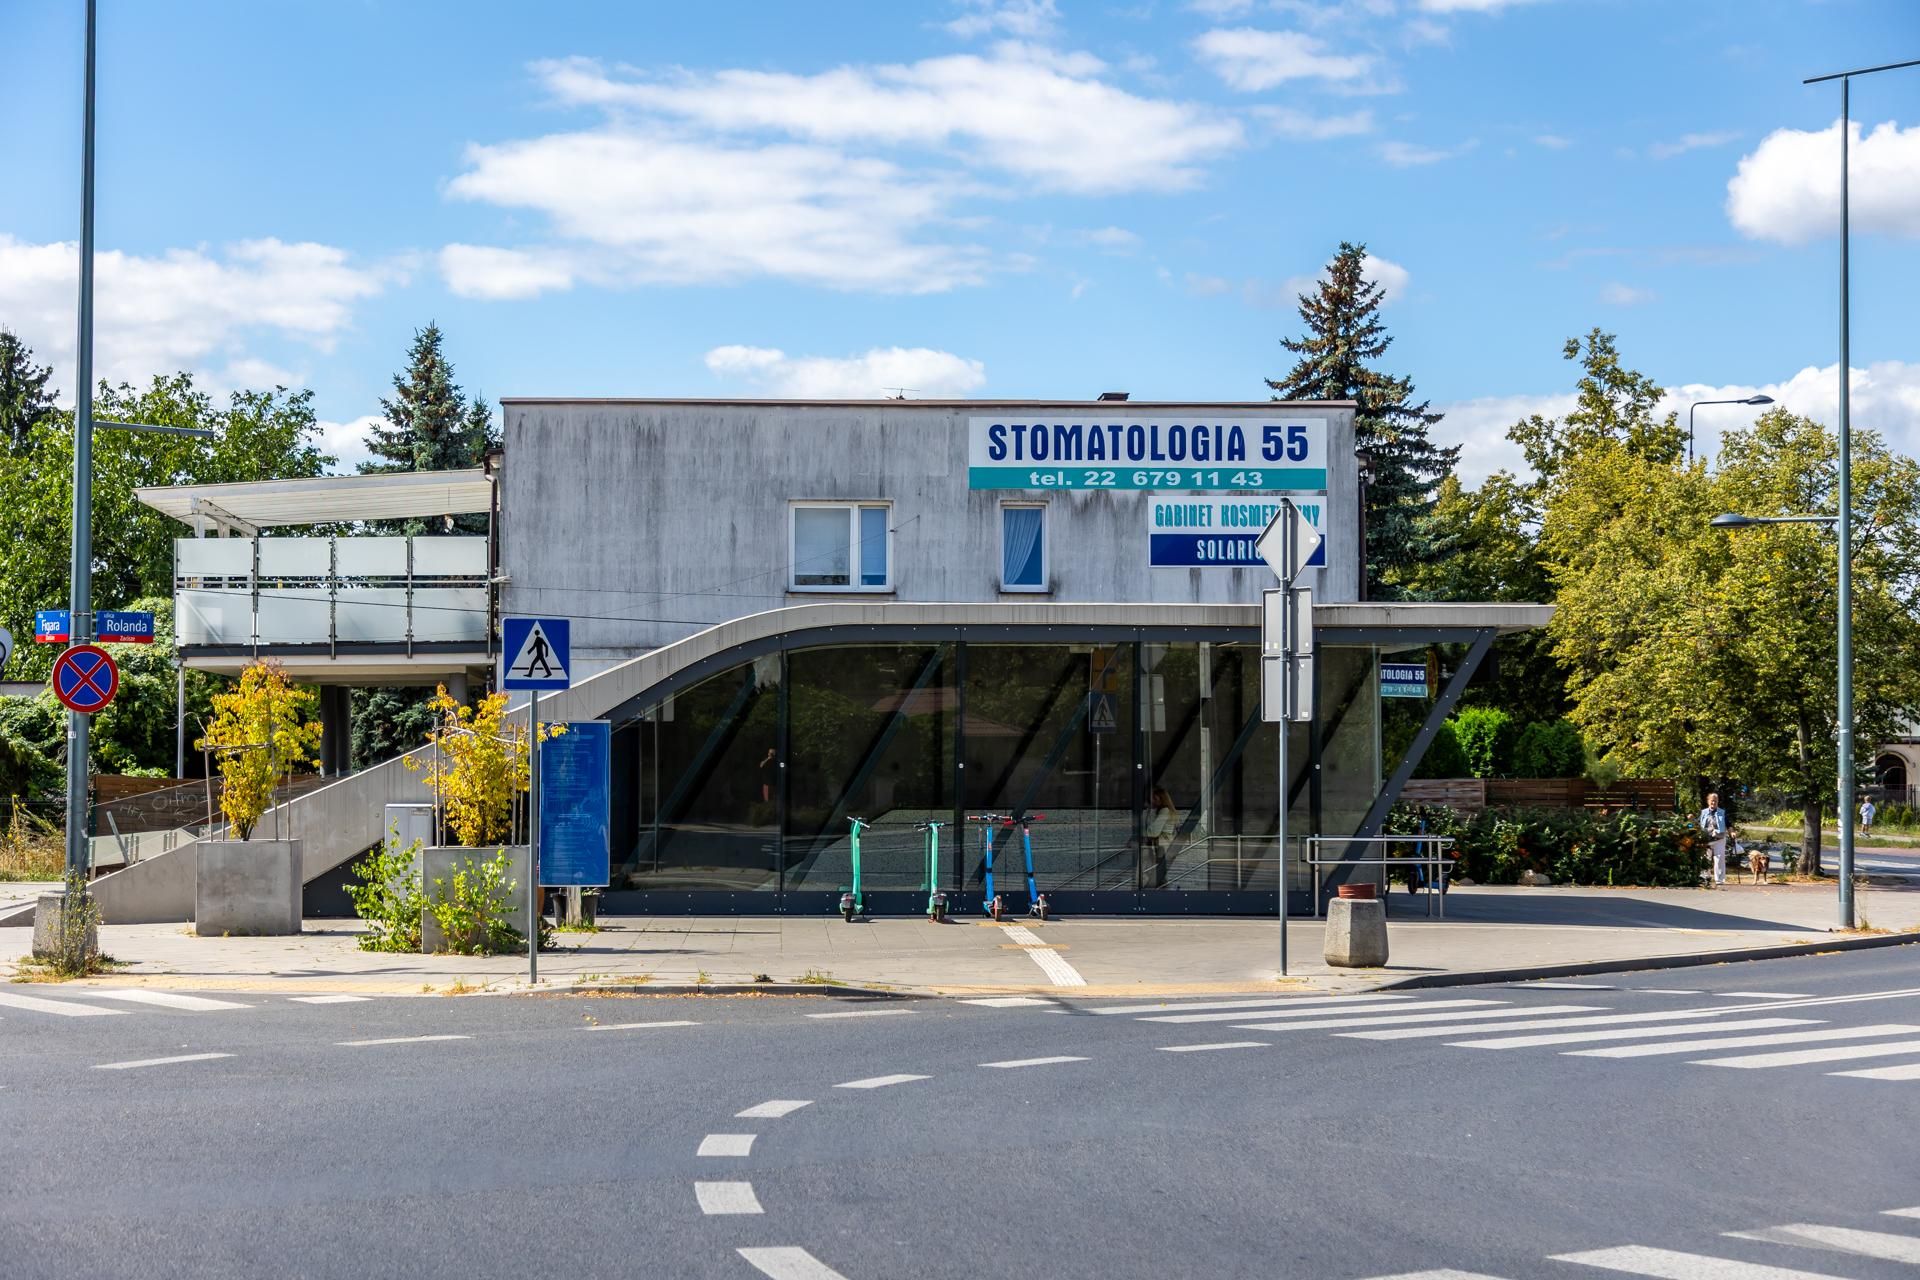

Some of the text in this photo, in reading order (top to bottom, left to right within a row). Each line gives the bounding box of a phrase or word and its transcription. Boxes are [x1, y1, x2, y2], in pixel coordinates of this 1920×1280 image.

[988, 424, 1308, 461] STOMATOLOGIA 55
[1030, 470, 1263, 486] tel. 22 679 11 43
[1155, 504, 1214, 528] GABINET
[41, 619, 60, 635] Figara
[106, 618, 148, 632] Rolanda
[1415, 670, 1425, 680] 55
